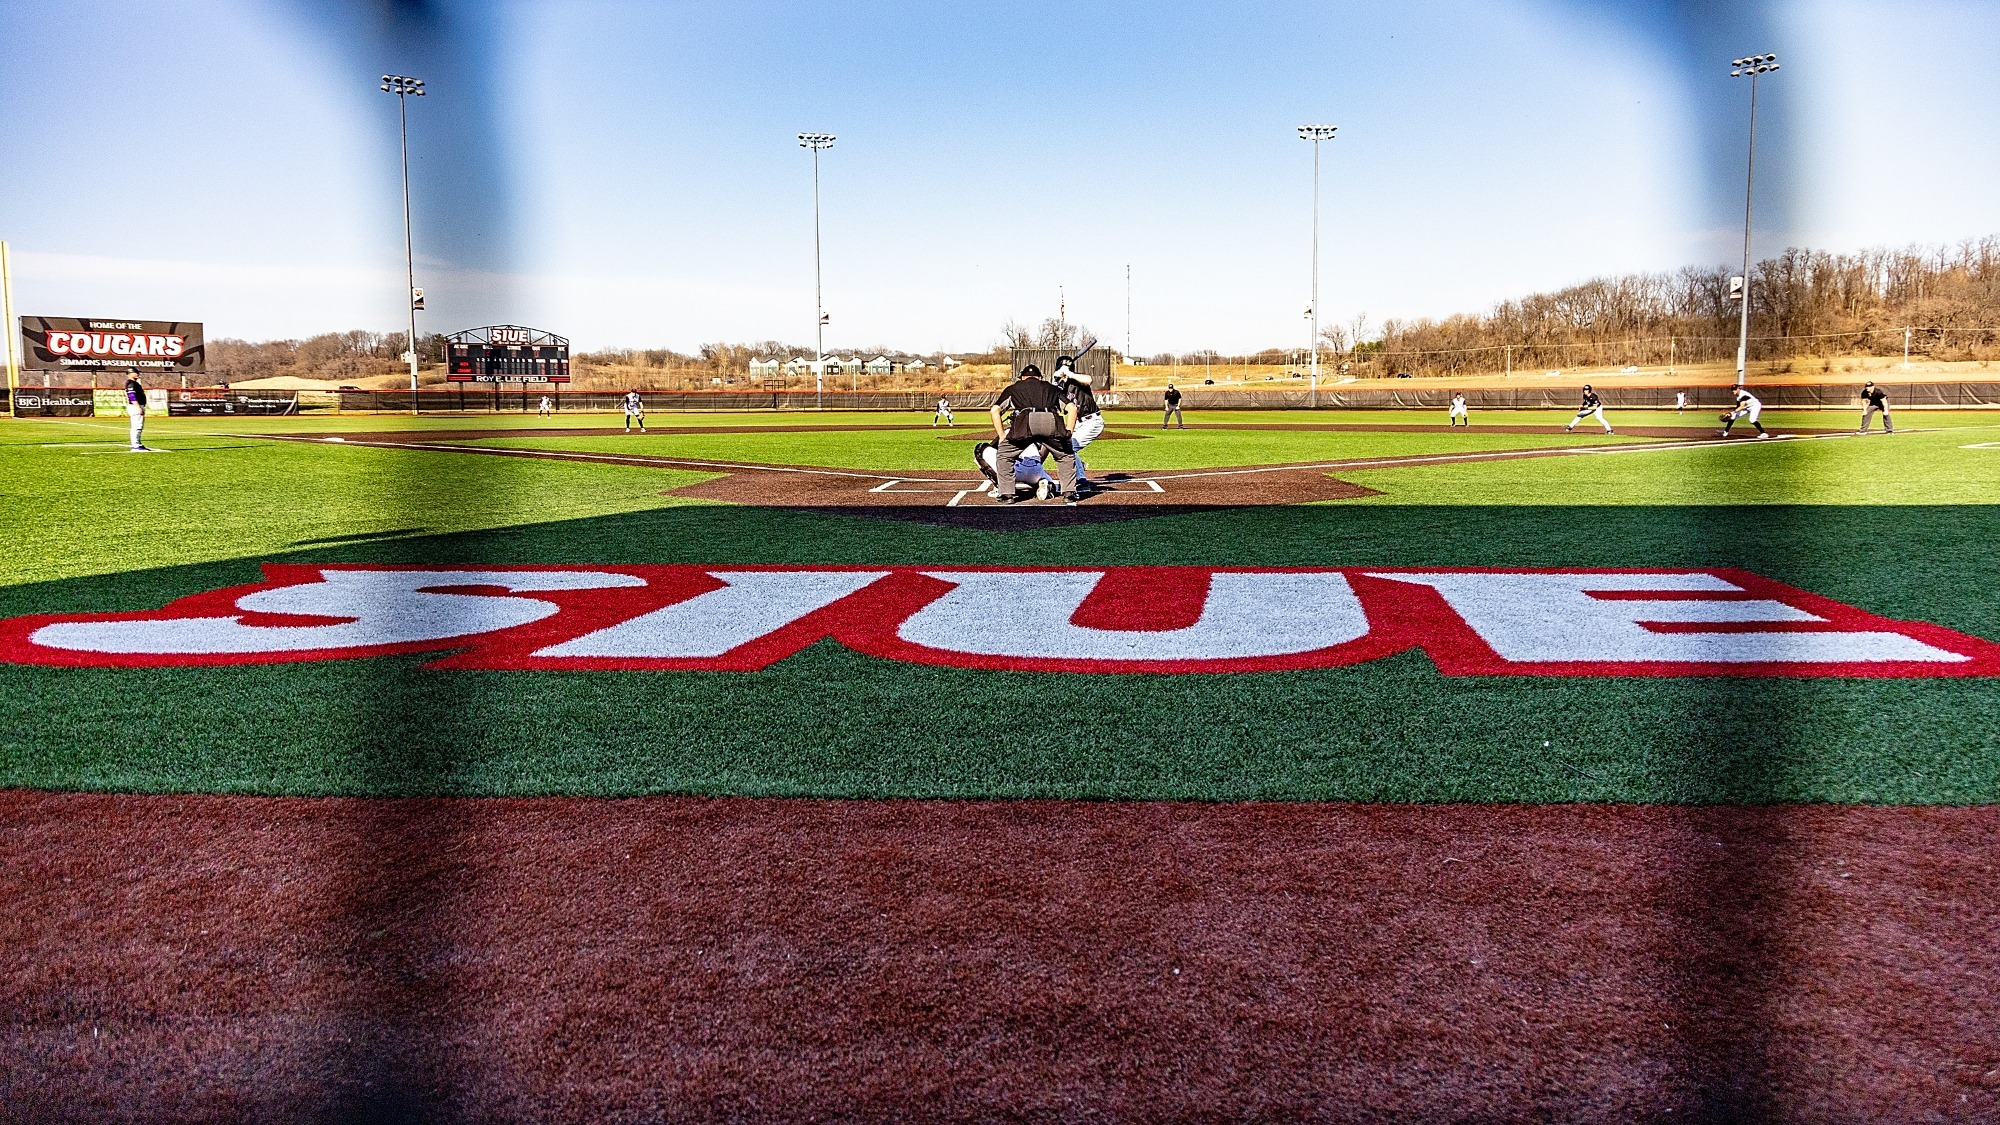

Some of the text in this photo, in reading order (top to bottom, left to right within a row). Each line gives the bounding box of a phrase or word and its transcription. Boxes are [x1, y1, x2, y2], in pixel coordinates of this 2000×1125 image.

[116, 322, 127, 330] OF
[491, 329, 528, 342] SIUE
[49, 332, 183, 356] COUGARS
[60, 358, 175, 368] SIMMONS BASEBALL COMPLEX
[18, 397, 37, 406] BJC
[42, 397, 93, 406] HealthCare
[28, 568, 1974, 664] SIUE
